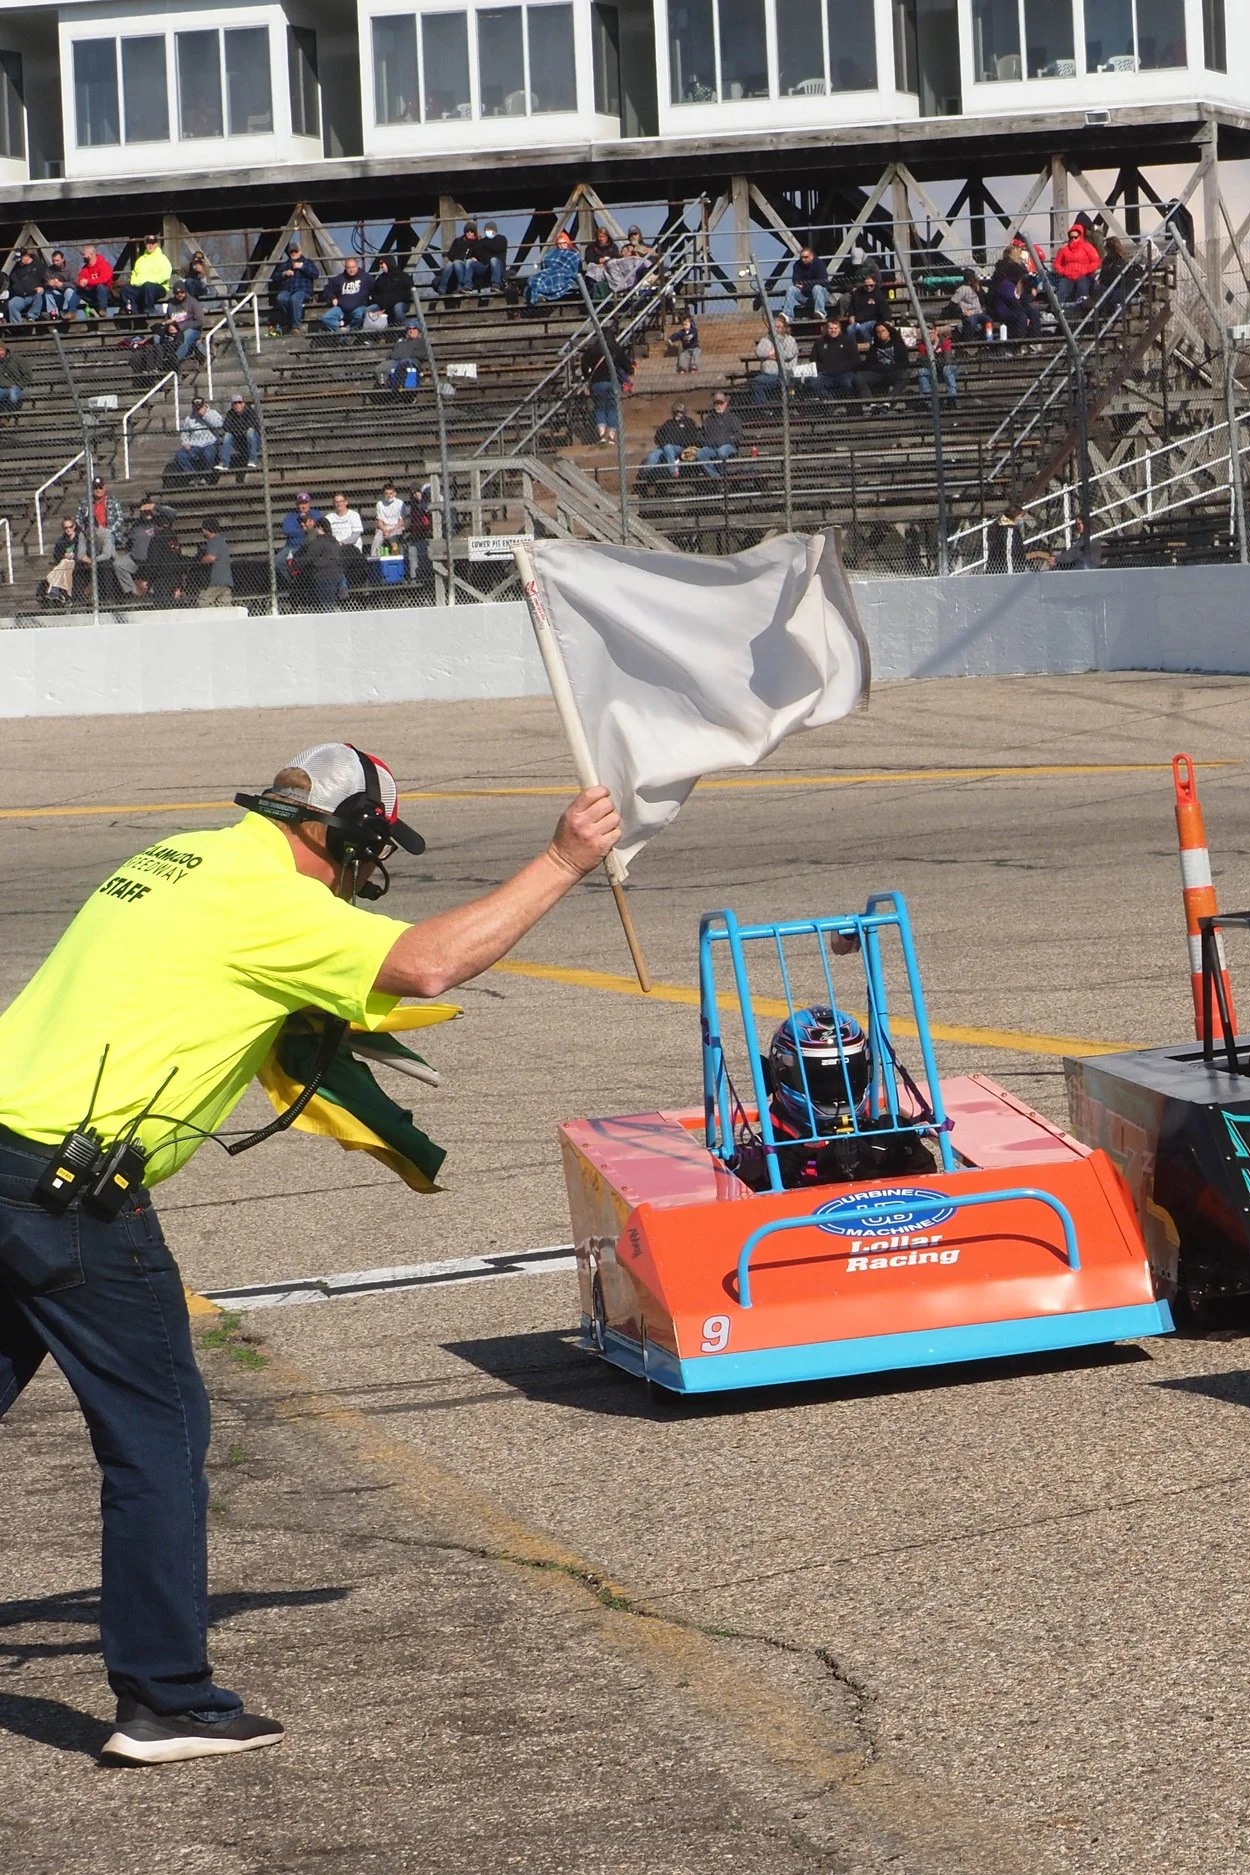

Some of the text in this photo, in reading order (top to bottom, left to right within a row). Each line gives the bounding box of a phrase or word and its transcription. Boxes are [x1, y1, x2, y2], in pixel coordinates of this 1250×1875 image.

[471, 540, 490, 548] LOWER
[124, 856, 188, 884] PEEDWAY
[99, 876, 152, 903] STAFF
[839, 1188, 915, 1204] URBINE
[845, 1219, 936, 1237] MACHINE
[850, 1234, 943, 1255] Lollar
[845, 1249, 960, 1272] Racing
[701, 1315, 731, 1353] 9
